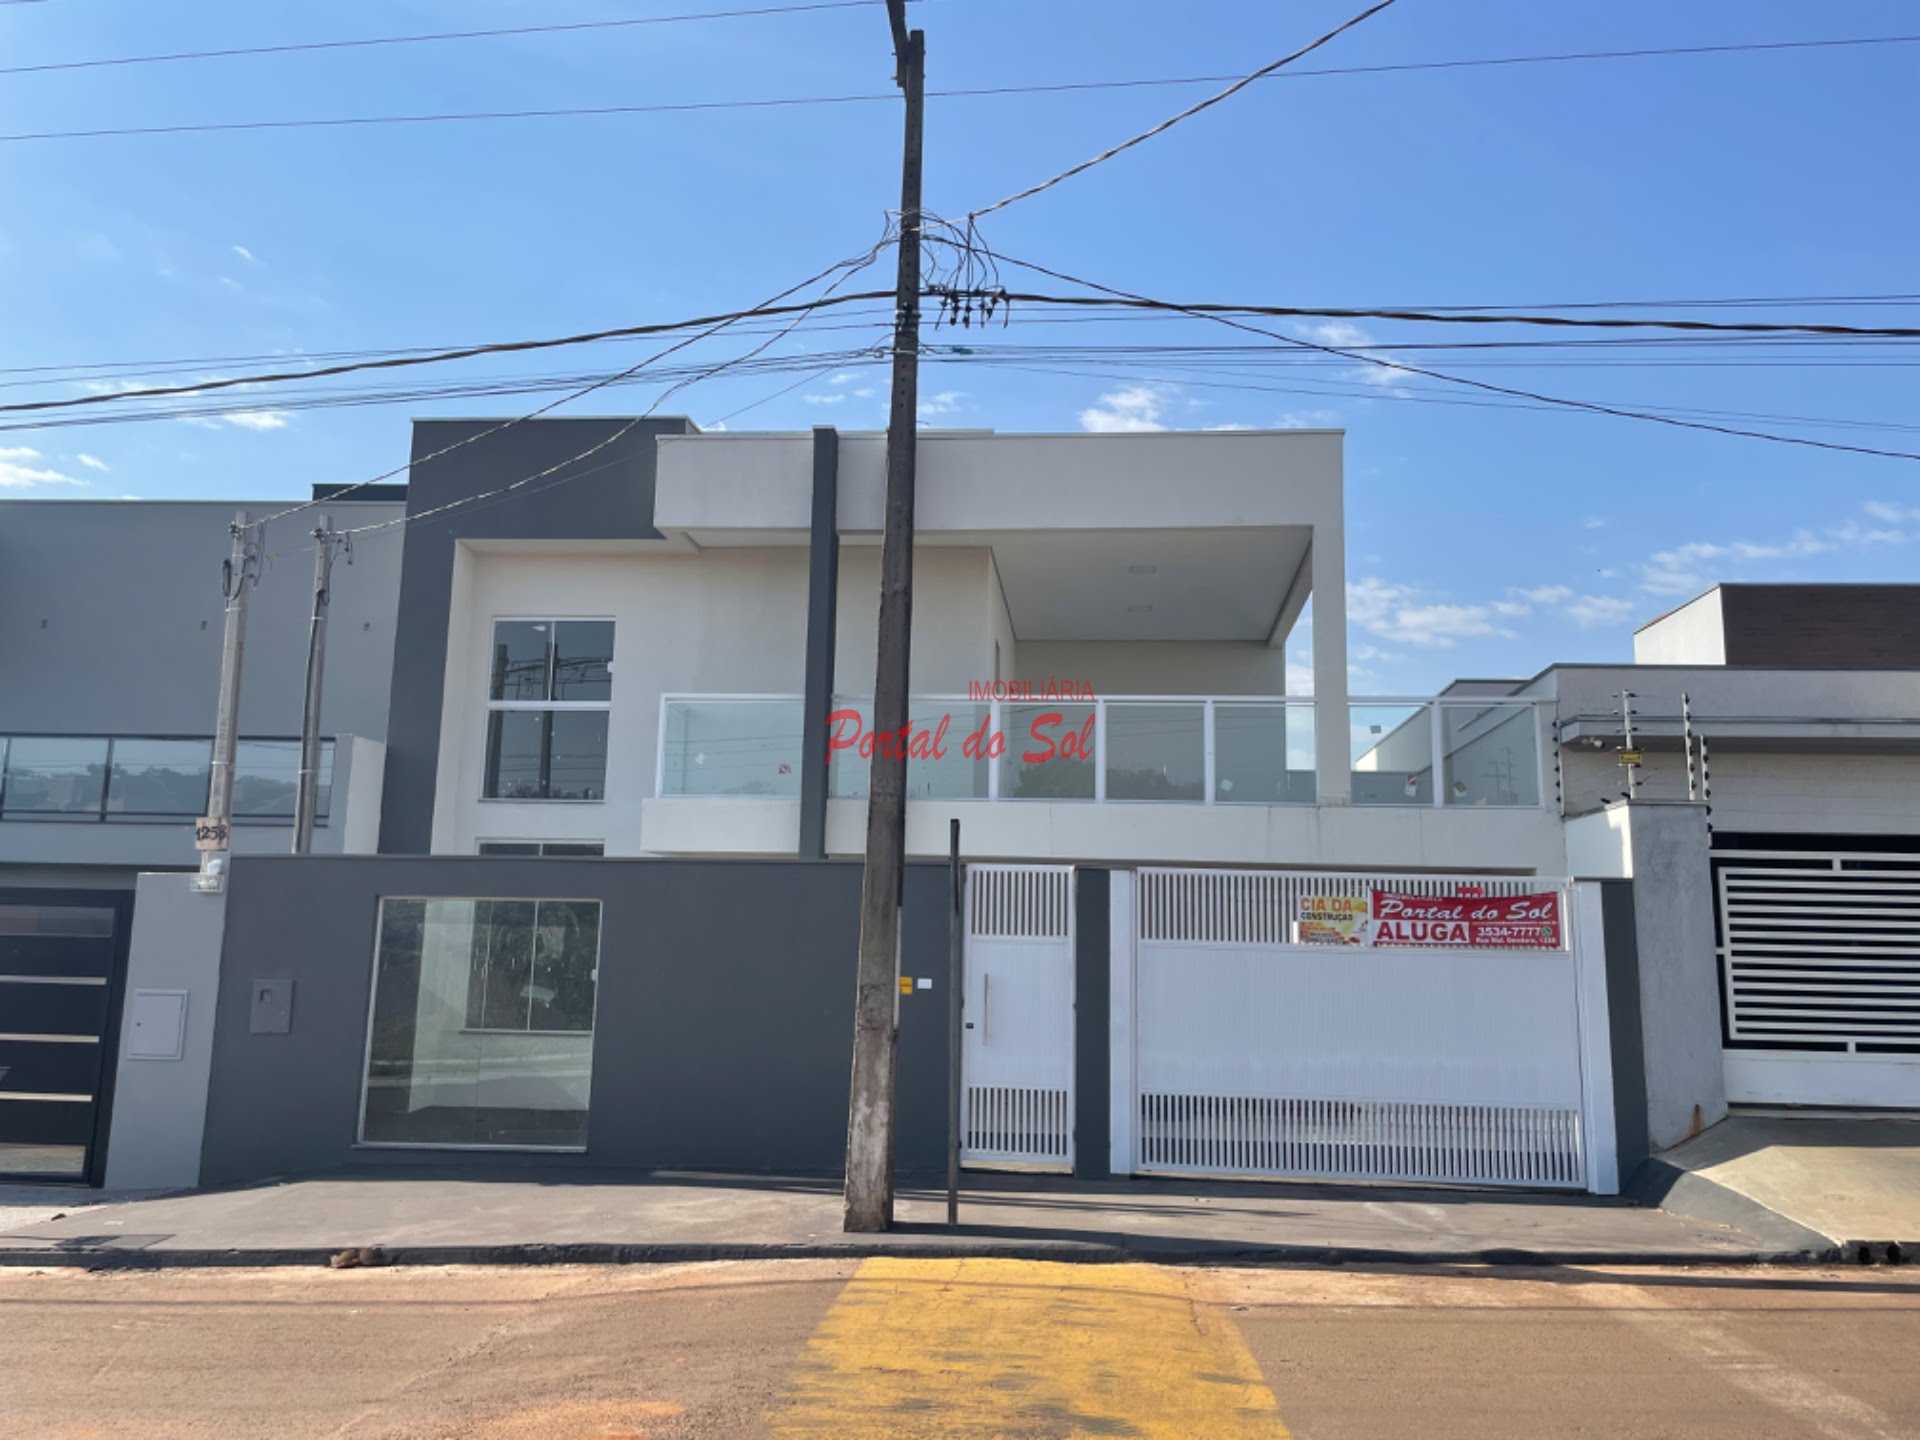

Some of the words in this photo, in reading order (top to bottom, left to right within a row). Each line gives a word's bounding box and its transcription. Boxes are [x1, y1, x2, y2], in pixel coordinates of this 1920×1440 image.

[1301, 897, 1326, 911] CIA
[1331, 898, 1352, 912] DA
[1380, 898, 1464, 919] Portal
[1471, 904, 1498, 919] do
[1506, 901, 1553, 919] Sol
[1376, 921, 1467, 941] ALUGA
[1477, 926, 1541, 937] 3534-7777
